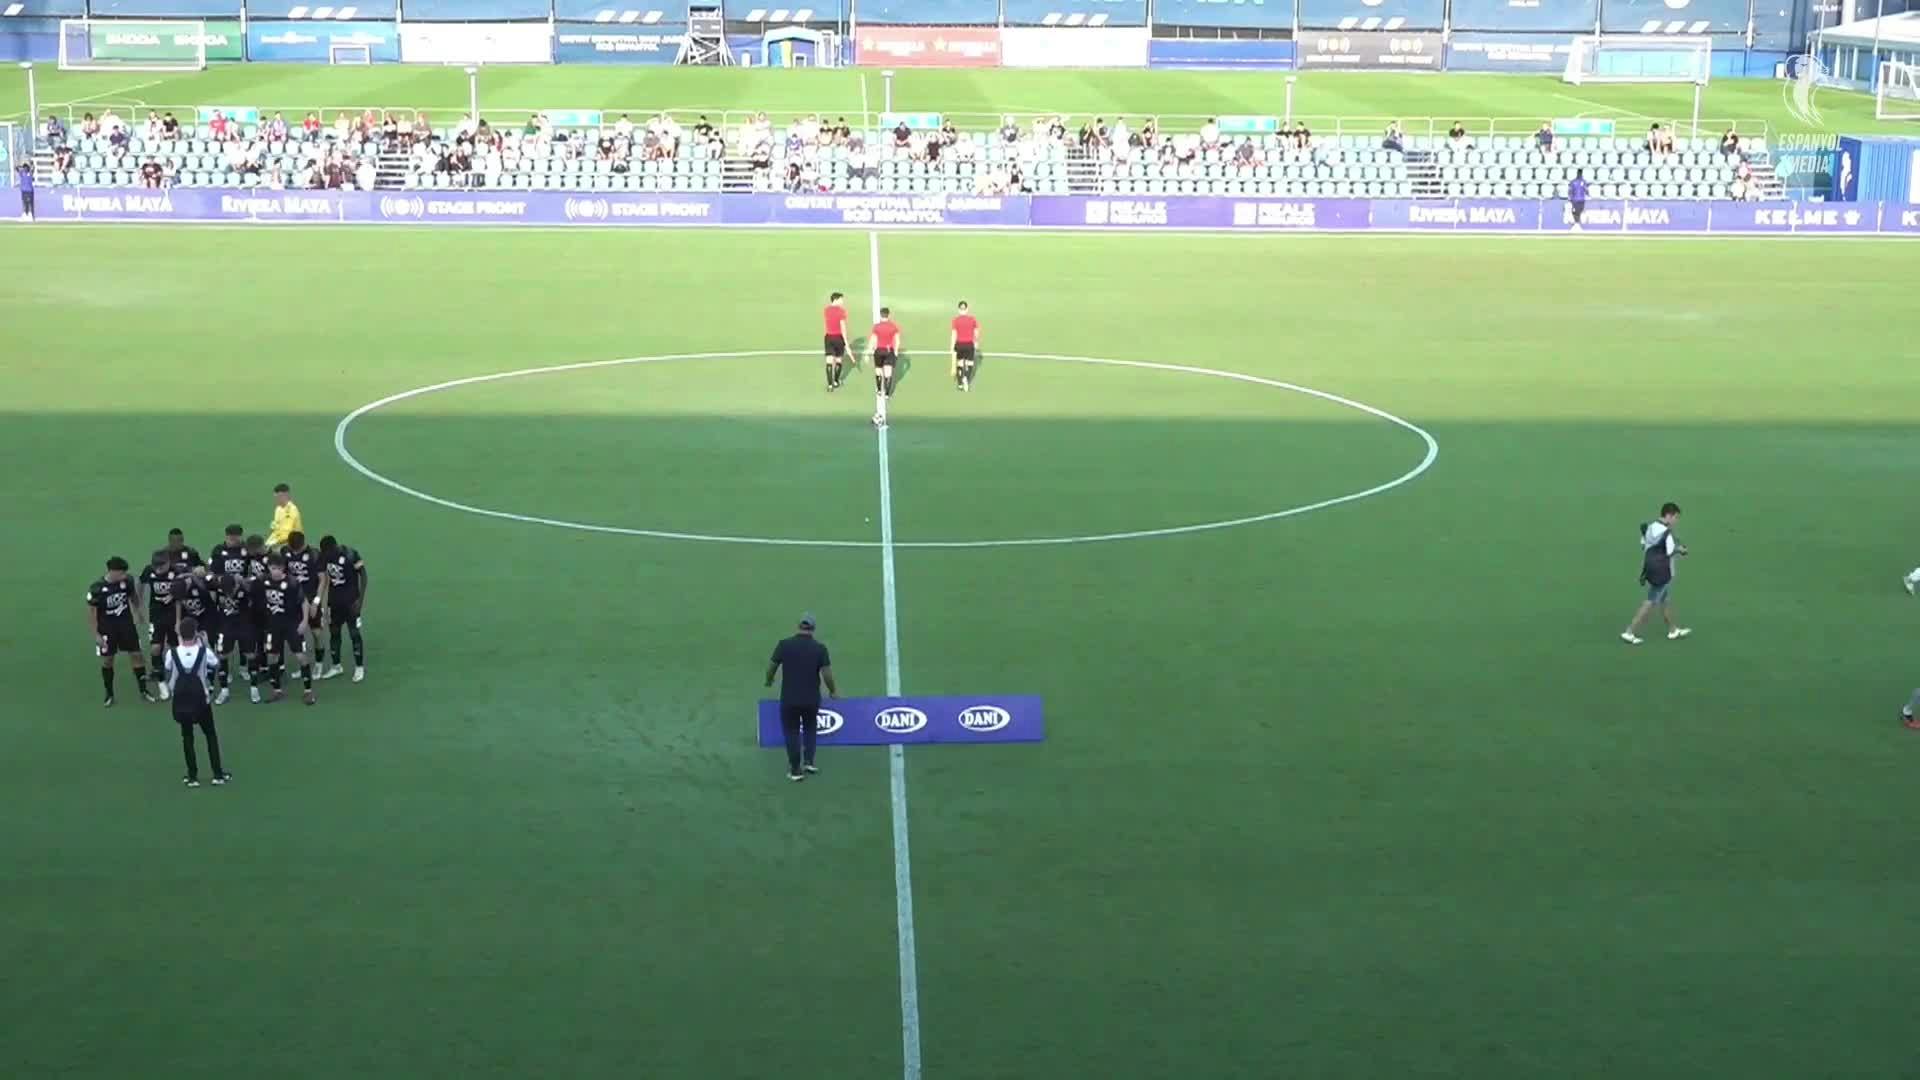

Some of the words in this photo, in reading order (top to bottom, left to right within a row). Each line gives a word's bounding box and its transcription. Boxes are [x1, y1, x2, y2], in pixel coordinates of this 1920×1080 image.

[125, 196, 173, 212] MAYA
[284, 196, 331, 213] MAYA
[428, 201, 473, 215] STAGE
[477, 202, 526, 215] FRONT
[612, 203, 657, 216] STAGE
[661, 203, 709, 217] FRONT
[1470, 207, 1515, 223] MAYA
[1563, 206, 1620, 224] RVIERA
[1624, 207, 1669, 224] MAYA
[1755, 210, 1837, 225] KELME
[881, 713, 916, 728] DANI
[963, 711, 999, 726] DANI
